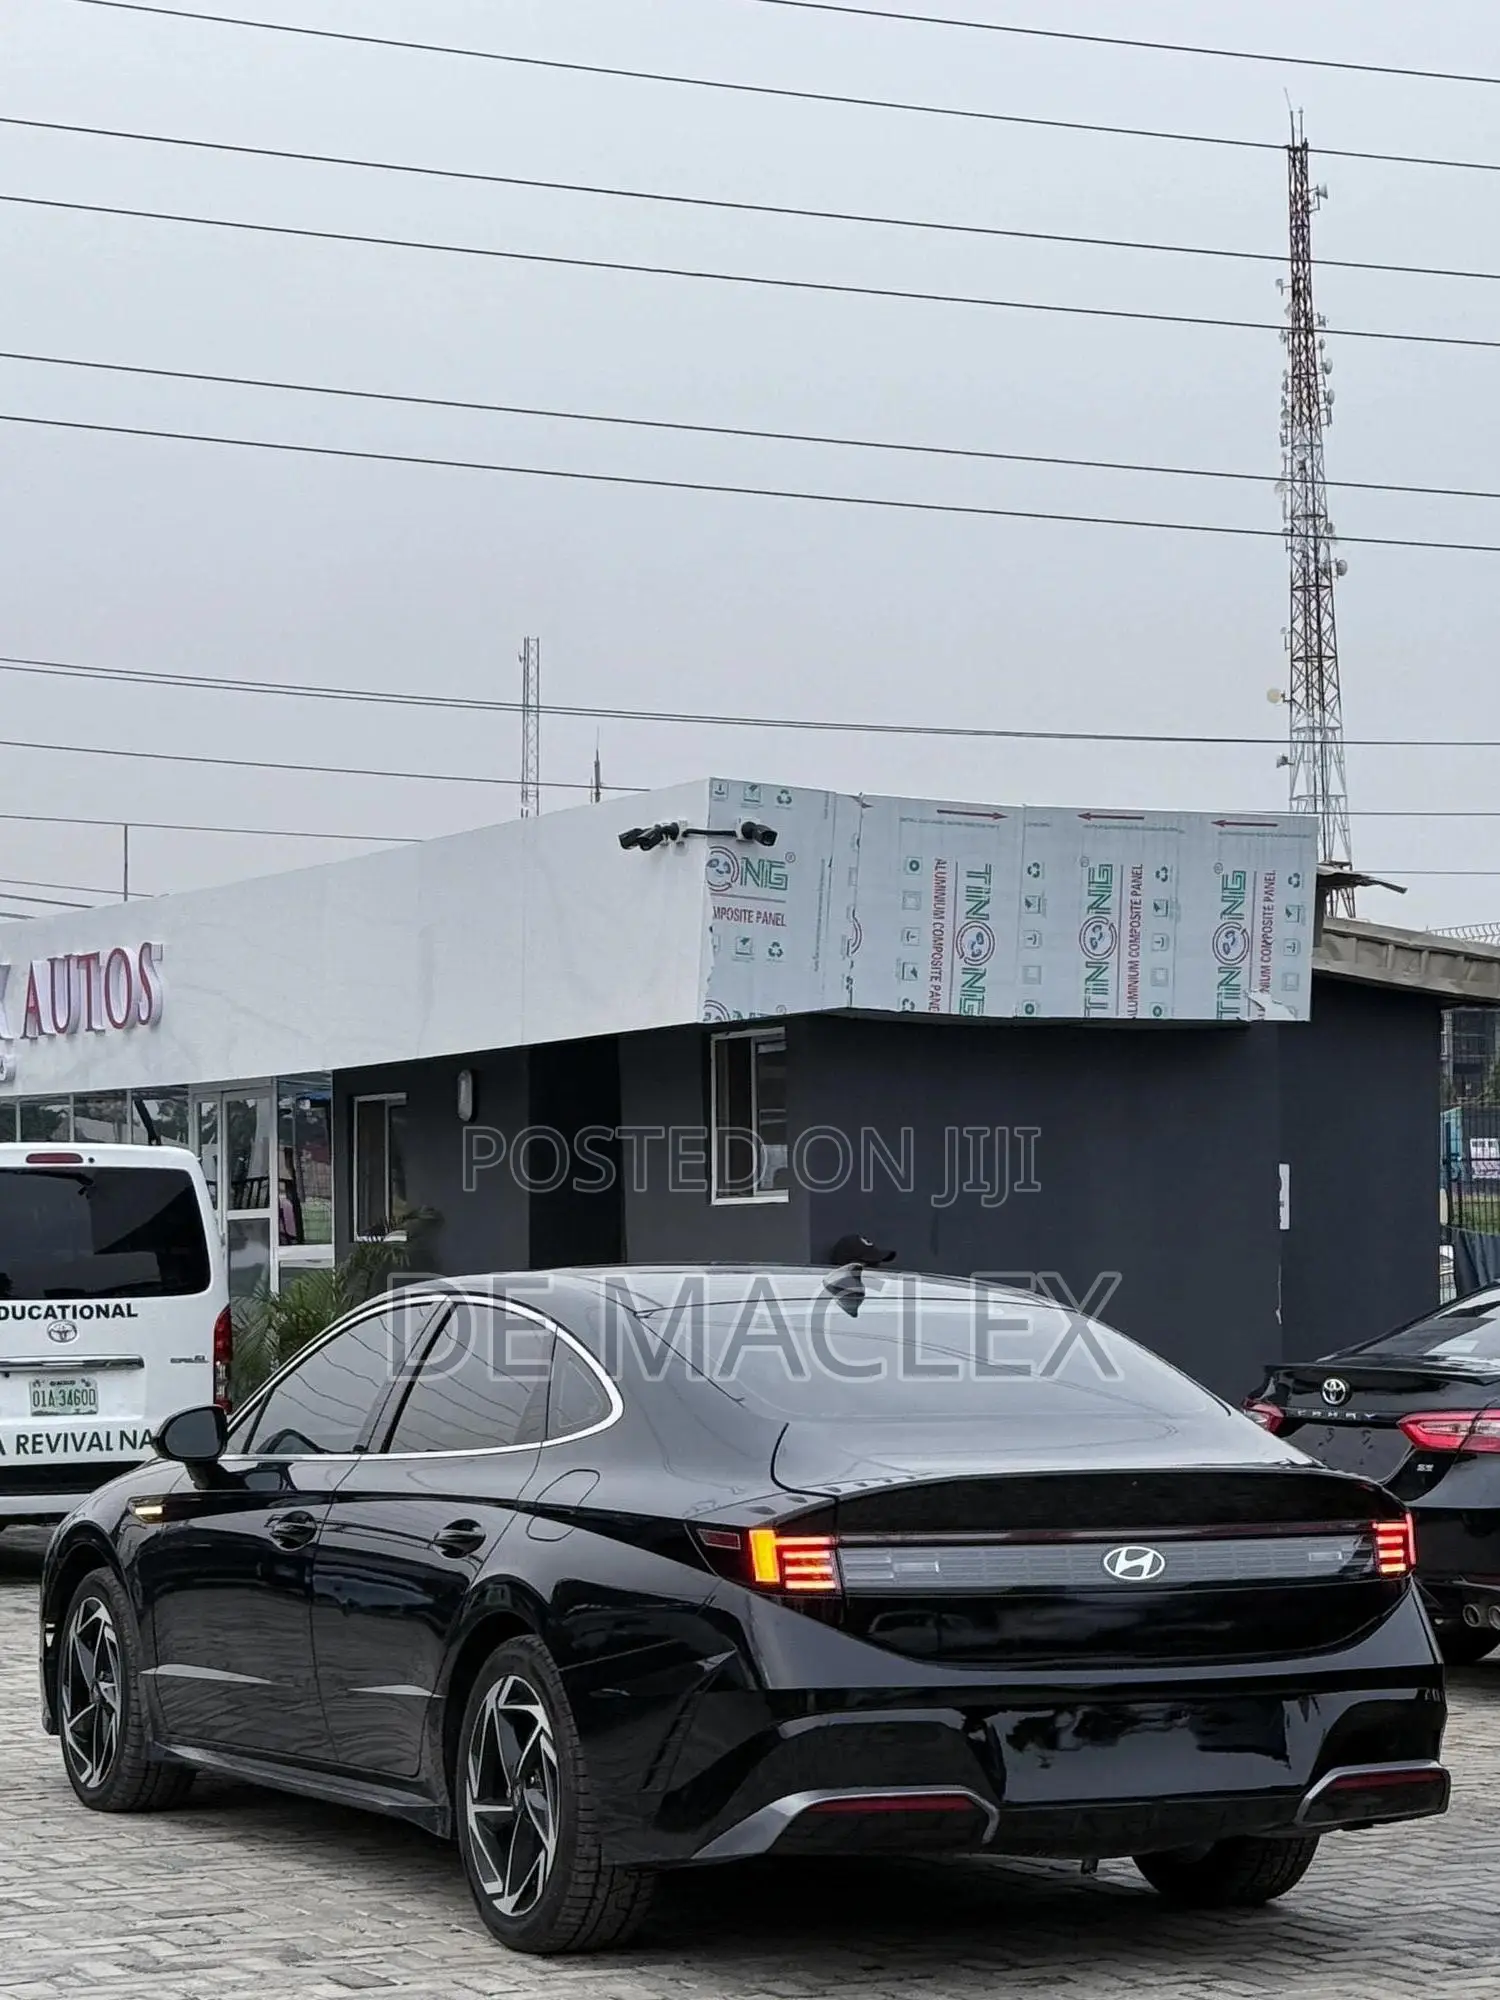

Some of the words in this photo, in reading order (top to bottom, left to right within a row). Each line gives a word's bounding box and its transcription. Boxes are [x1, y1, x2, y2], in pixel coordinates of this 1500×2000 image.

[932, 858, 947, 921] ALUMINIUM
[1130, 864, 1143, 897] PANEL
[1263, 870, 1276, 902] PANEL
[756, 910, 787, 926] PANEL
[1129, 899, 1142, 958] COMPOSITE
[1261, 905, 1275, 967] COMPOSITE
[930, 923, 945, 982] COMPOSITE
[20, 941, 162, 1039] AUTOS
[16, 1431, 113, 1455] REVIVAL
